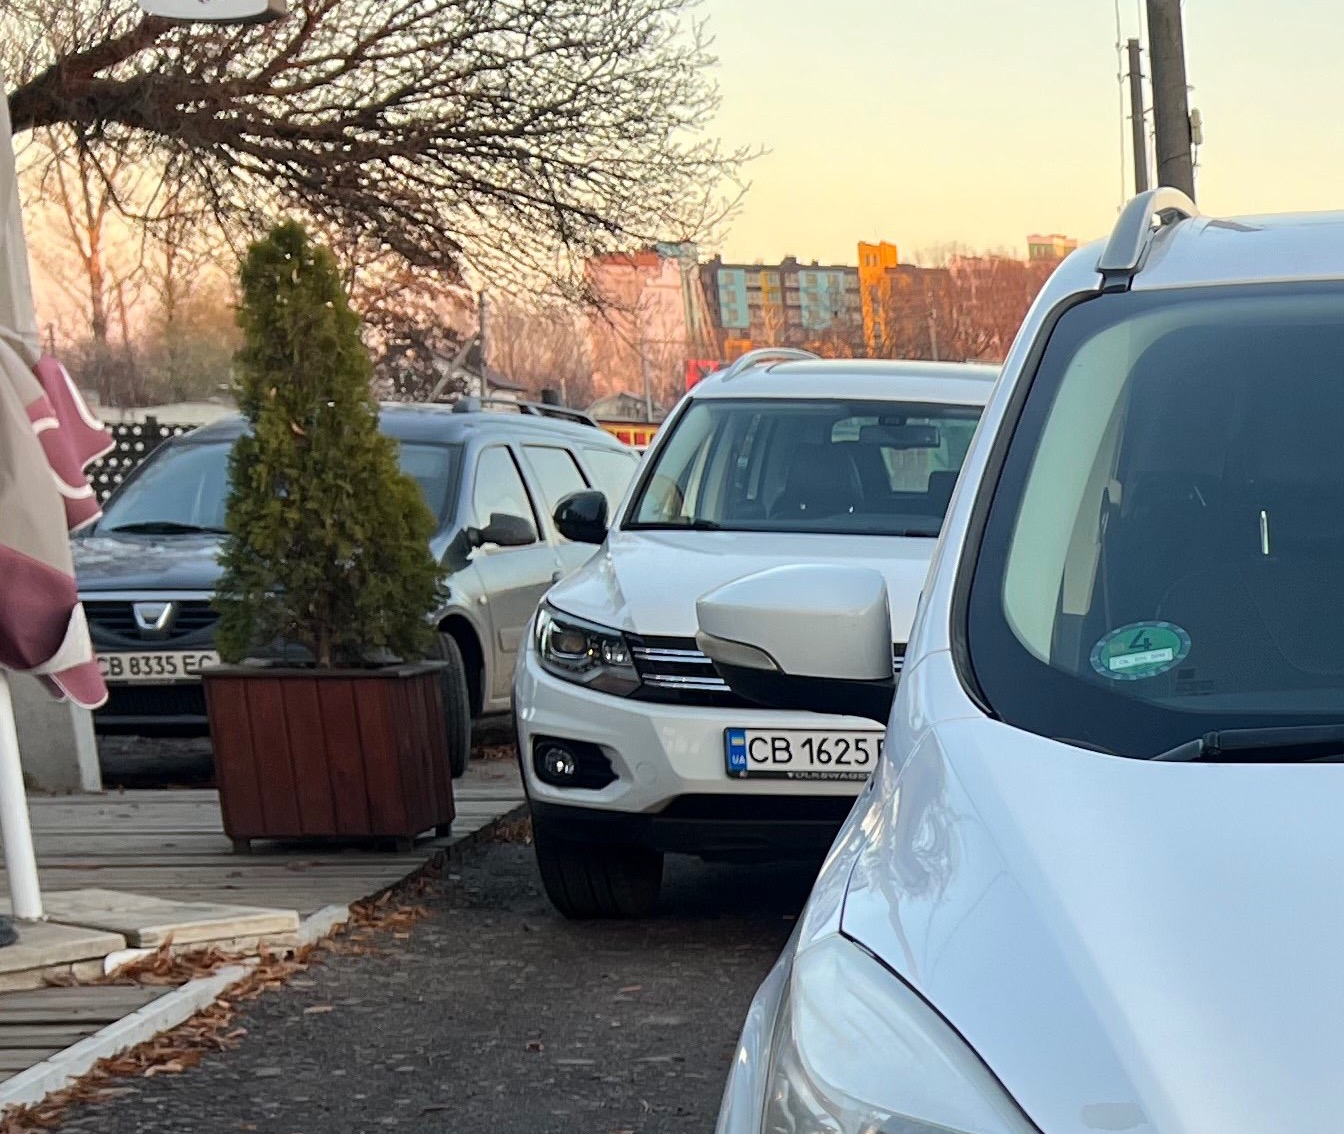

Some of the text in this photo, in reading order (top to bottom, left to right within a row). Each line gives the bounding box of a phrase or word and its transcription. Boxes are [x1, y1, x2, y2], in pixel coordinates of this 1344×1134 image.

[1128, 629, 1153, 651] 4
[129, 655, 178, 676] 8335
[732, 754, 746, 765] UA
[749, 737, 793, 764] CB
[801, 738, 870, 765] 1625
